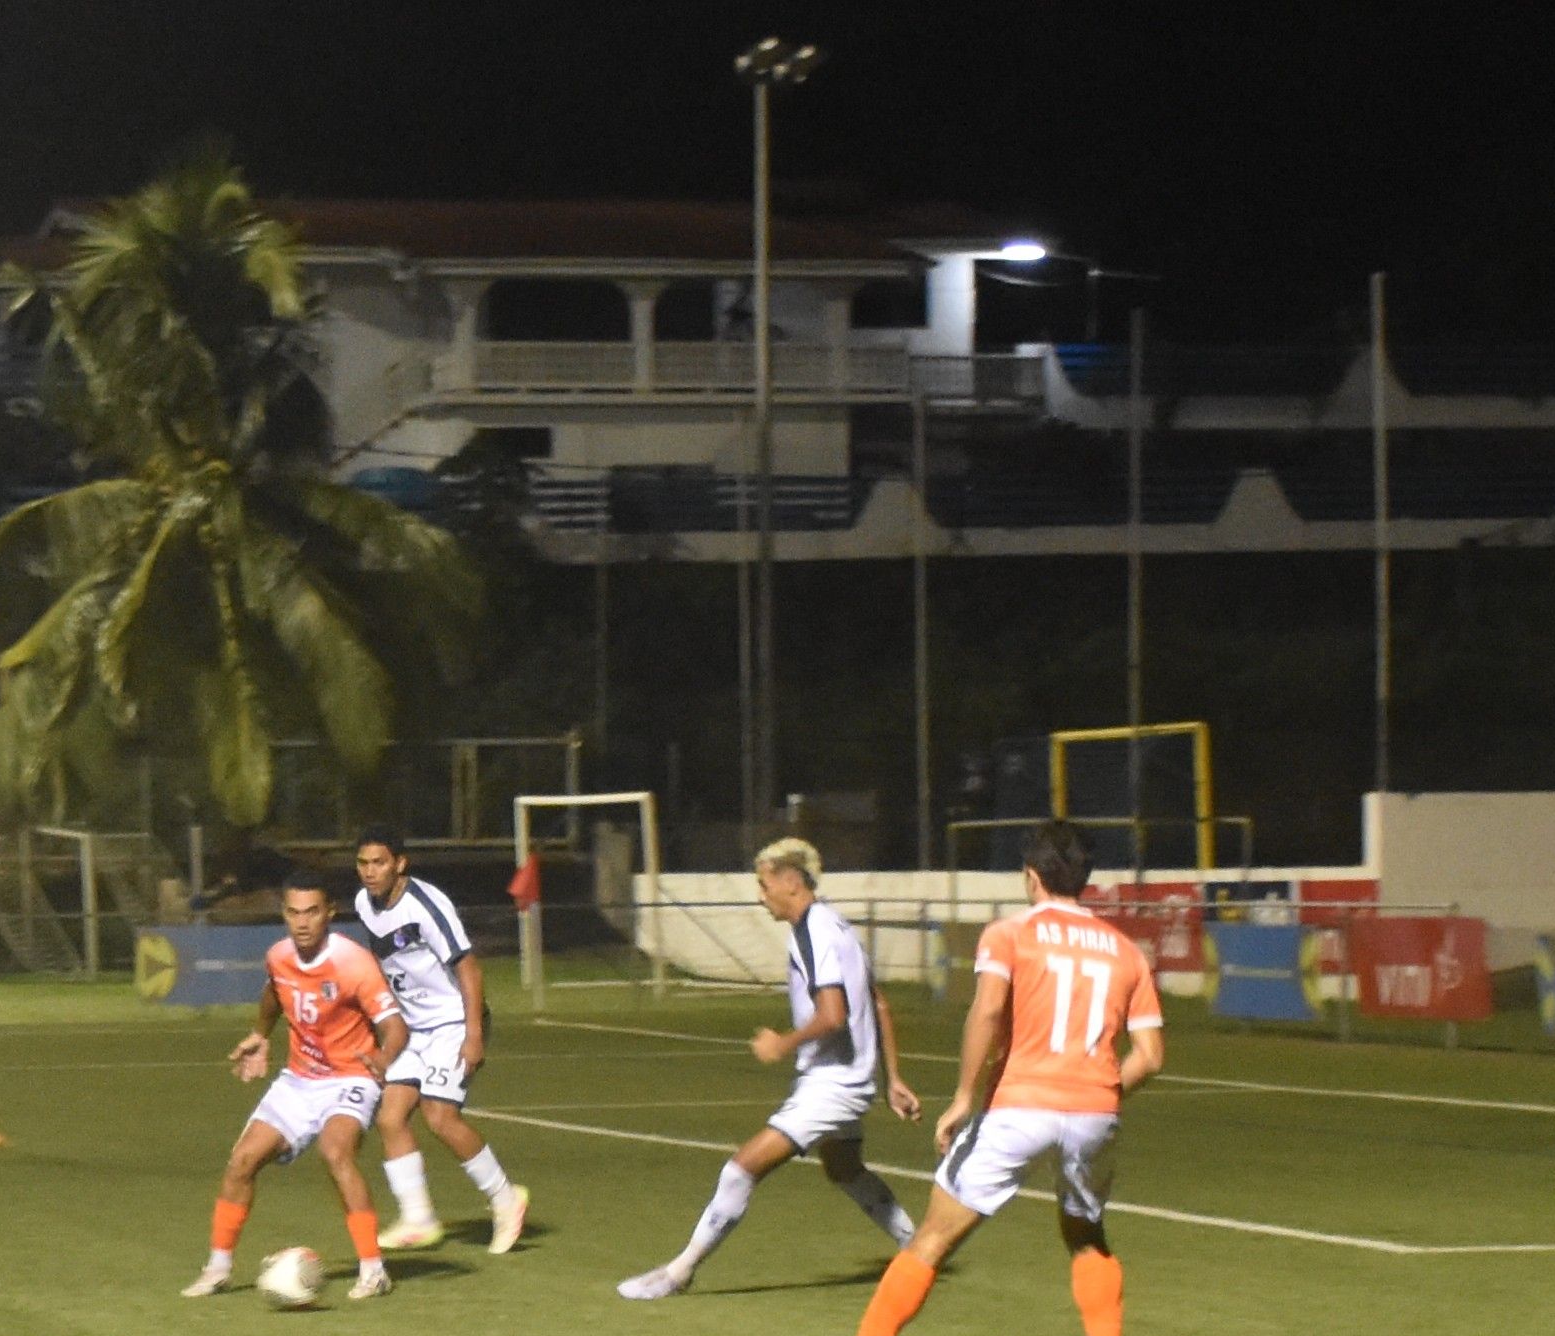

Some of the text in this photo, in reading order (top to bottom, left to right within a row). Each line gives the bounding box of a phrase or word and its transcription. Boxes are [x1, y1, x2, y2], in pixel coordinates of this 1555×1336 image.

[1037, 922, 1062, 945] AS
[292, 989, 318, 1025] 15
[1046, 953, 1112, 1057] 11
[425, 1065, 450, 1087] 25
